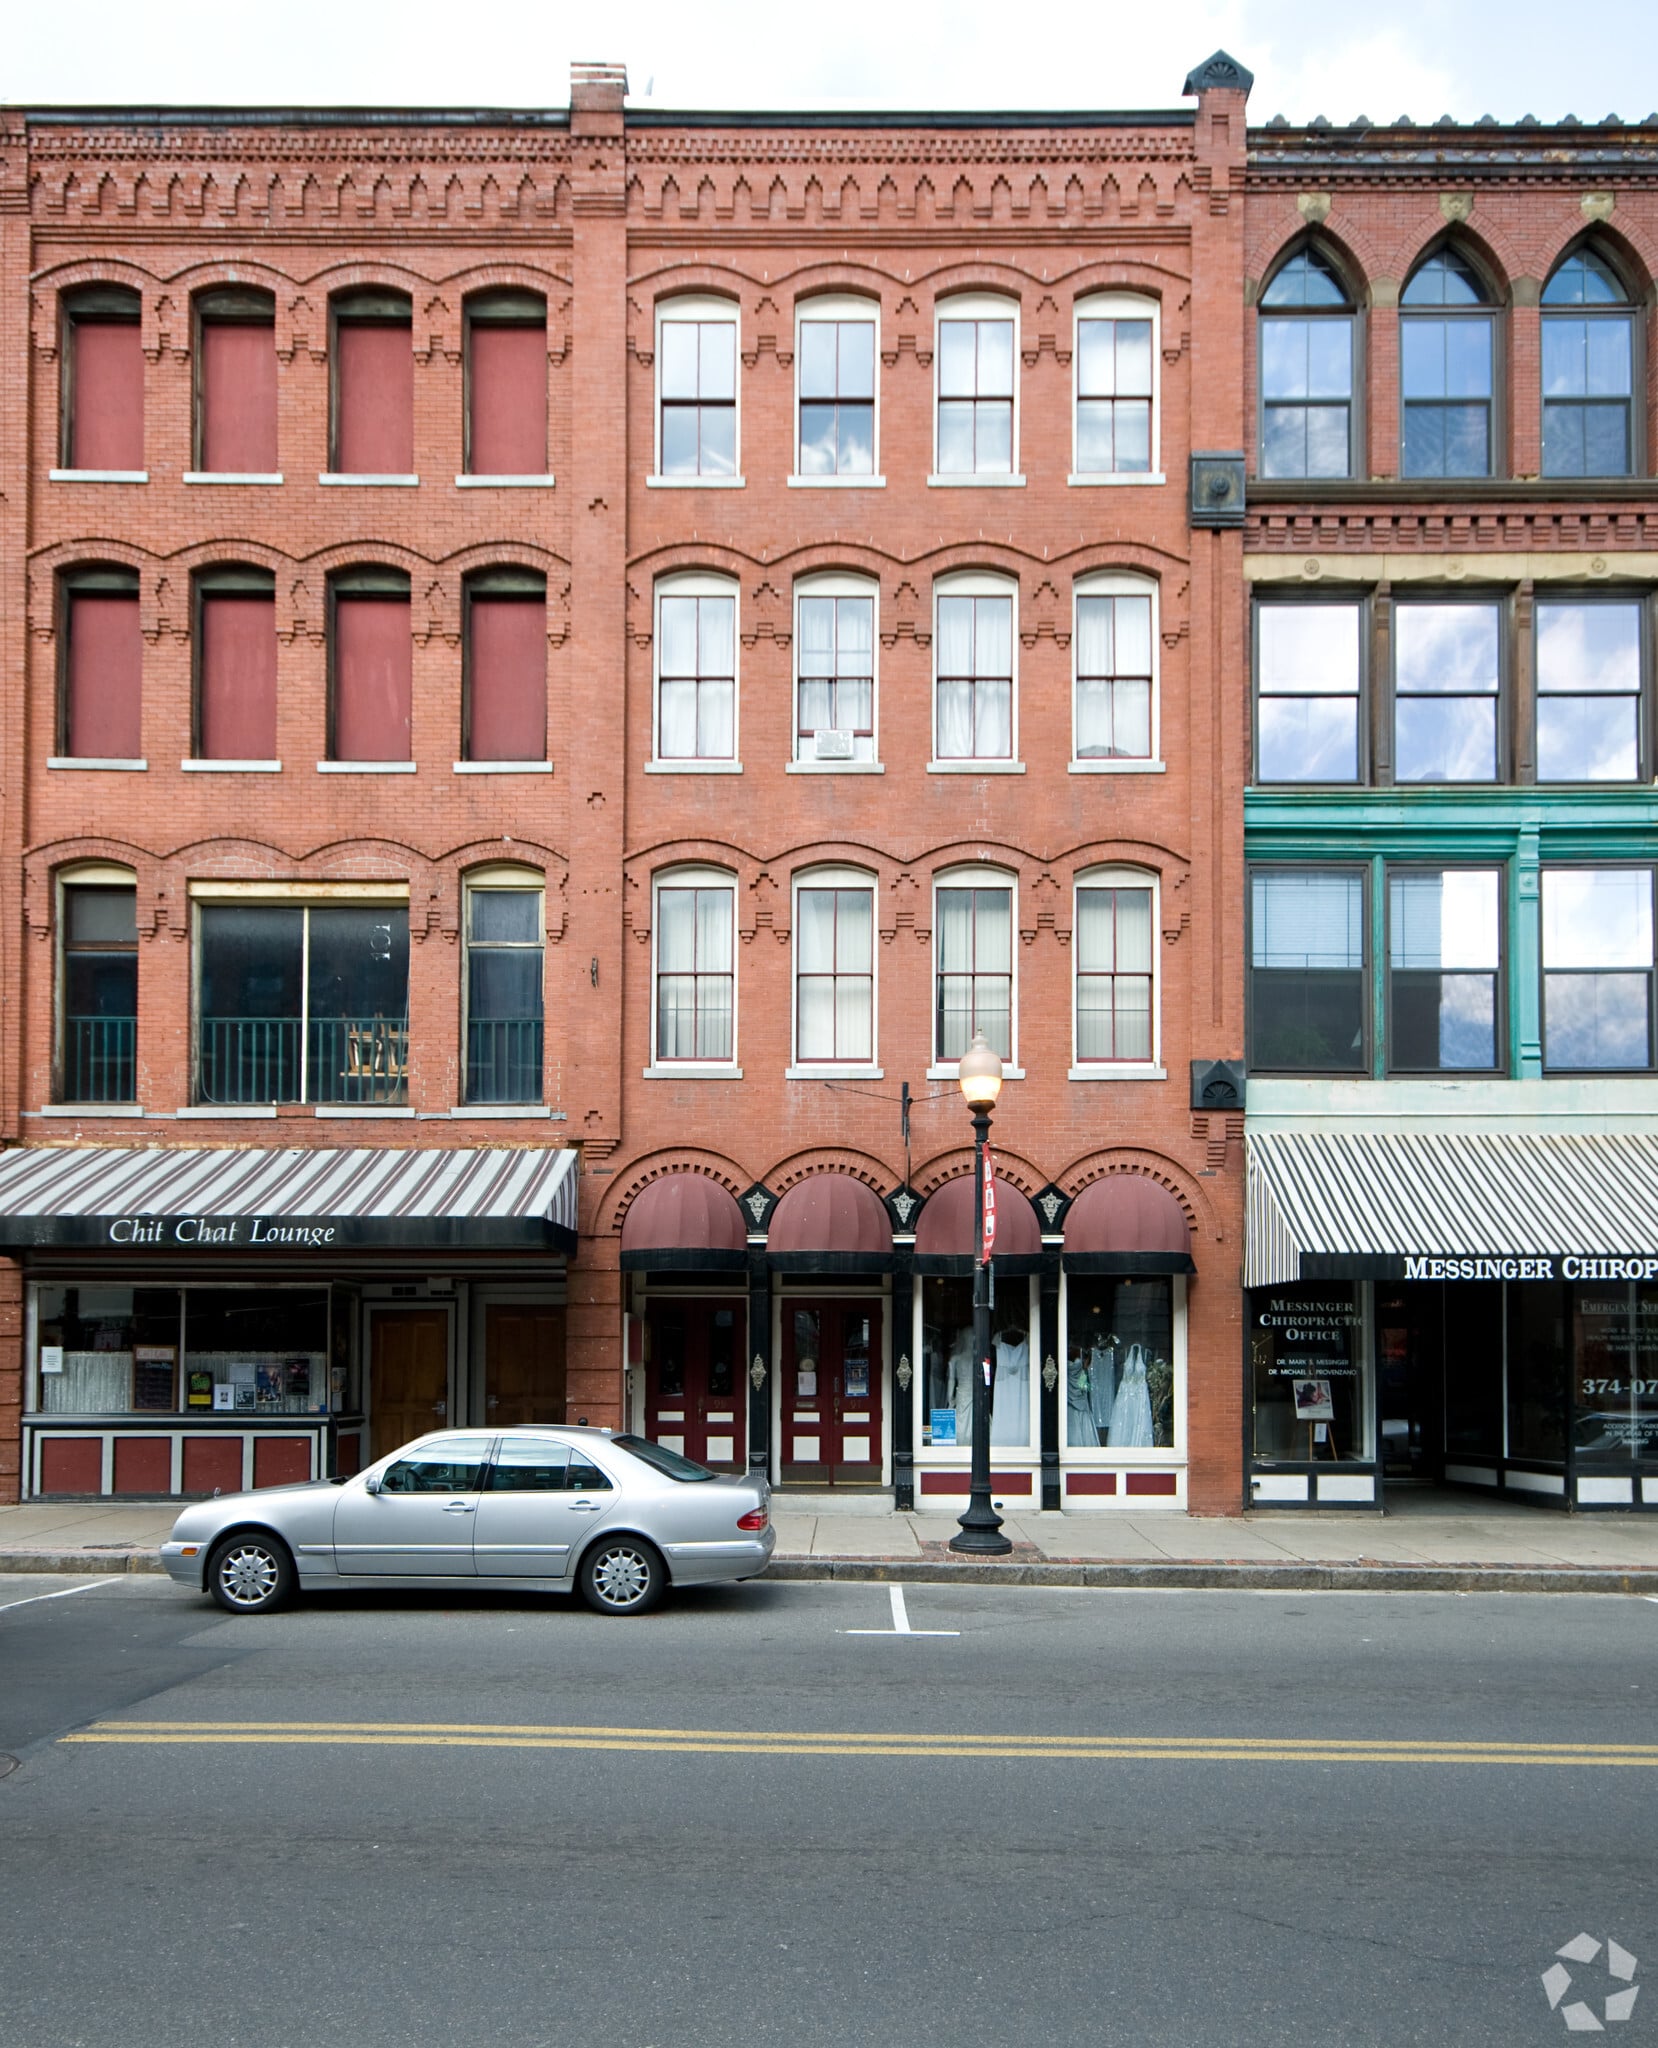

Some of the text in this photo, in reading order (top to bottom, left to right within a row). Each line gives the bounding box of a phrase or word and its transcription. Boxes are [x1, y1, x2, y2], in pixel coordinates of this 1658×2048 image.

[109, 1219, 335, 1246] Chit Chat Lounge
[1403, 1256, 1658, 1280] MESSINGER CHIROP
[1270, 1299, 1354, 1312] MESSINGER
[1285, 1328, 1341, 1341] OFFICE
[1582, 1378, 1658, 1395] 374-07
